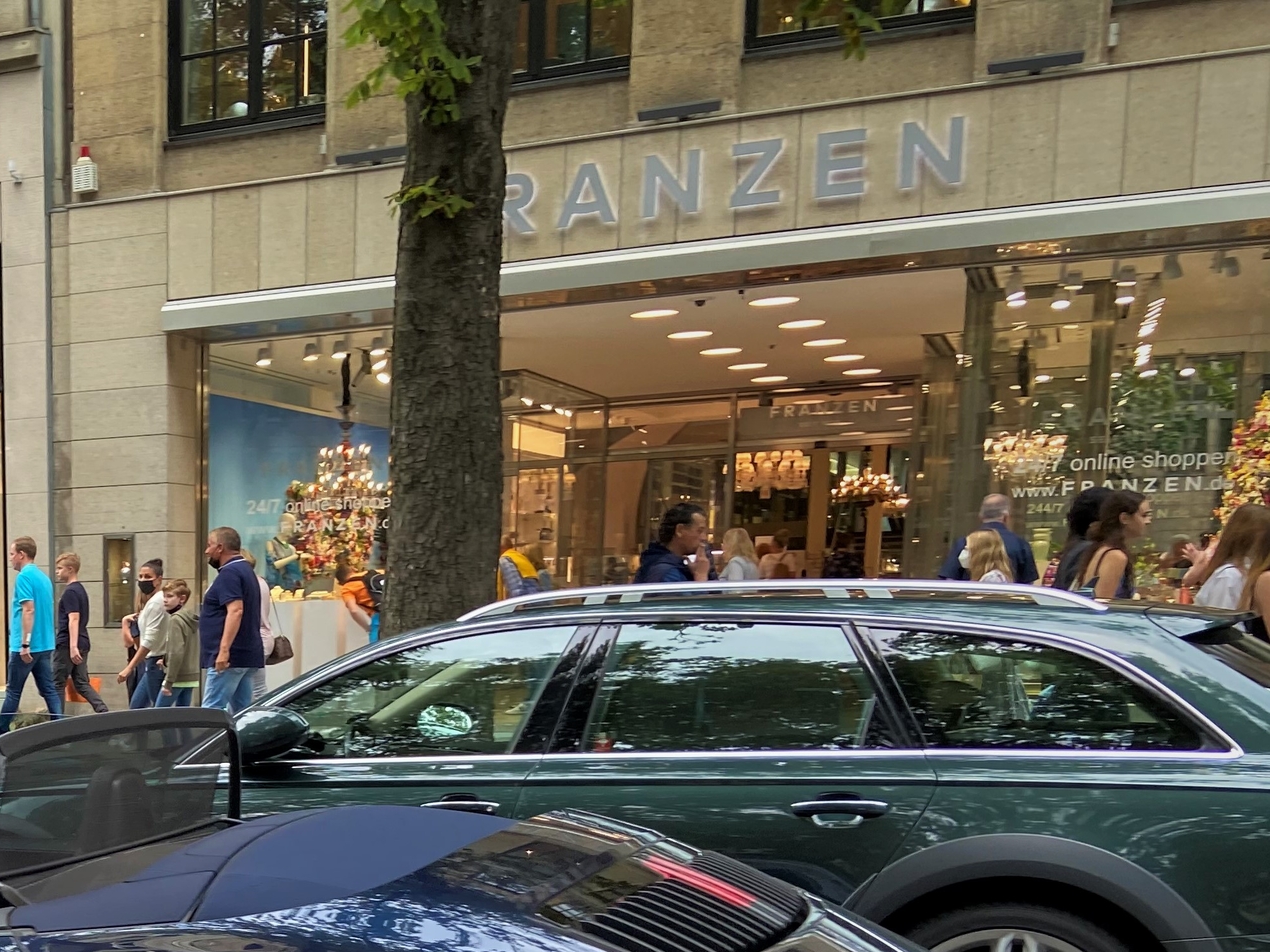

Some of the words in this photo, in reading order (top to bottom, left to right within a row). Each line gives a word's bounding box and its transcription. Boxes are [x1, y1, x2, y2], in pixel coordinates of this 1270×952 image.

[769, 399, 878, 419] FRANZEN
[1070, 453, 1135, 471] online
[247, 497, 282, 515] 24/7
[285, 498, 330, 515] online
